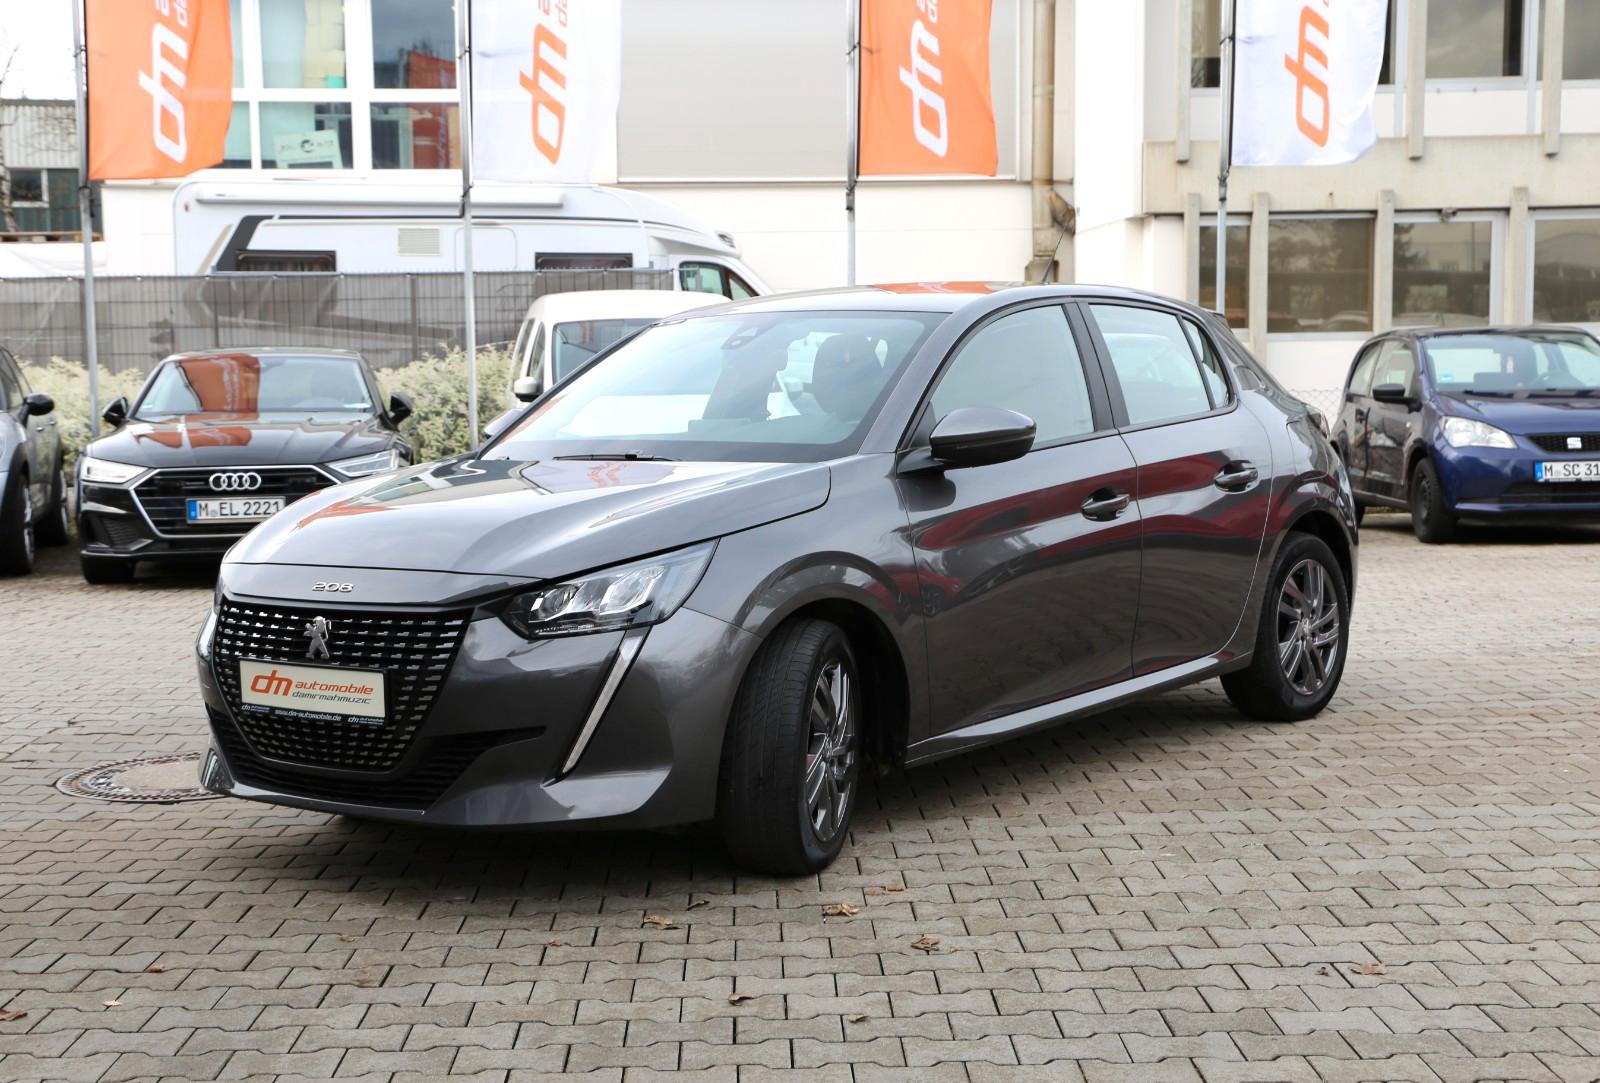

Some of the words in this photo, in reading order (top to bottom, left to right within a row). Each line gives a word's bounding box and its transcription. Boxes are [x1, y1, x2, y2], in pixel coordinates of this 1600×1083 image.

[1544, 463, 1554, 477] M
[1563, 463, 1581, 477] SC
[198, 502, 209, 517] M
[219, 501, 240, 516] EL
[243, 501, 280, 516] 2221
[312, 581, 354, 593] 208
[250, 669, 293, 697] dm
[295, 680, 374, 695] automobile
